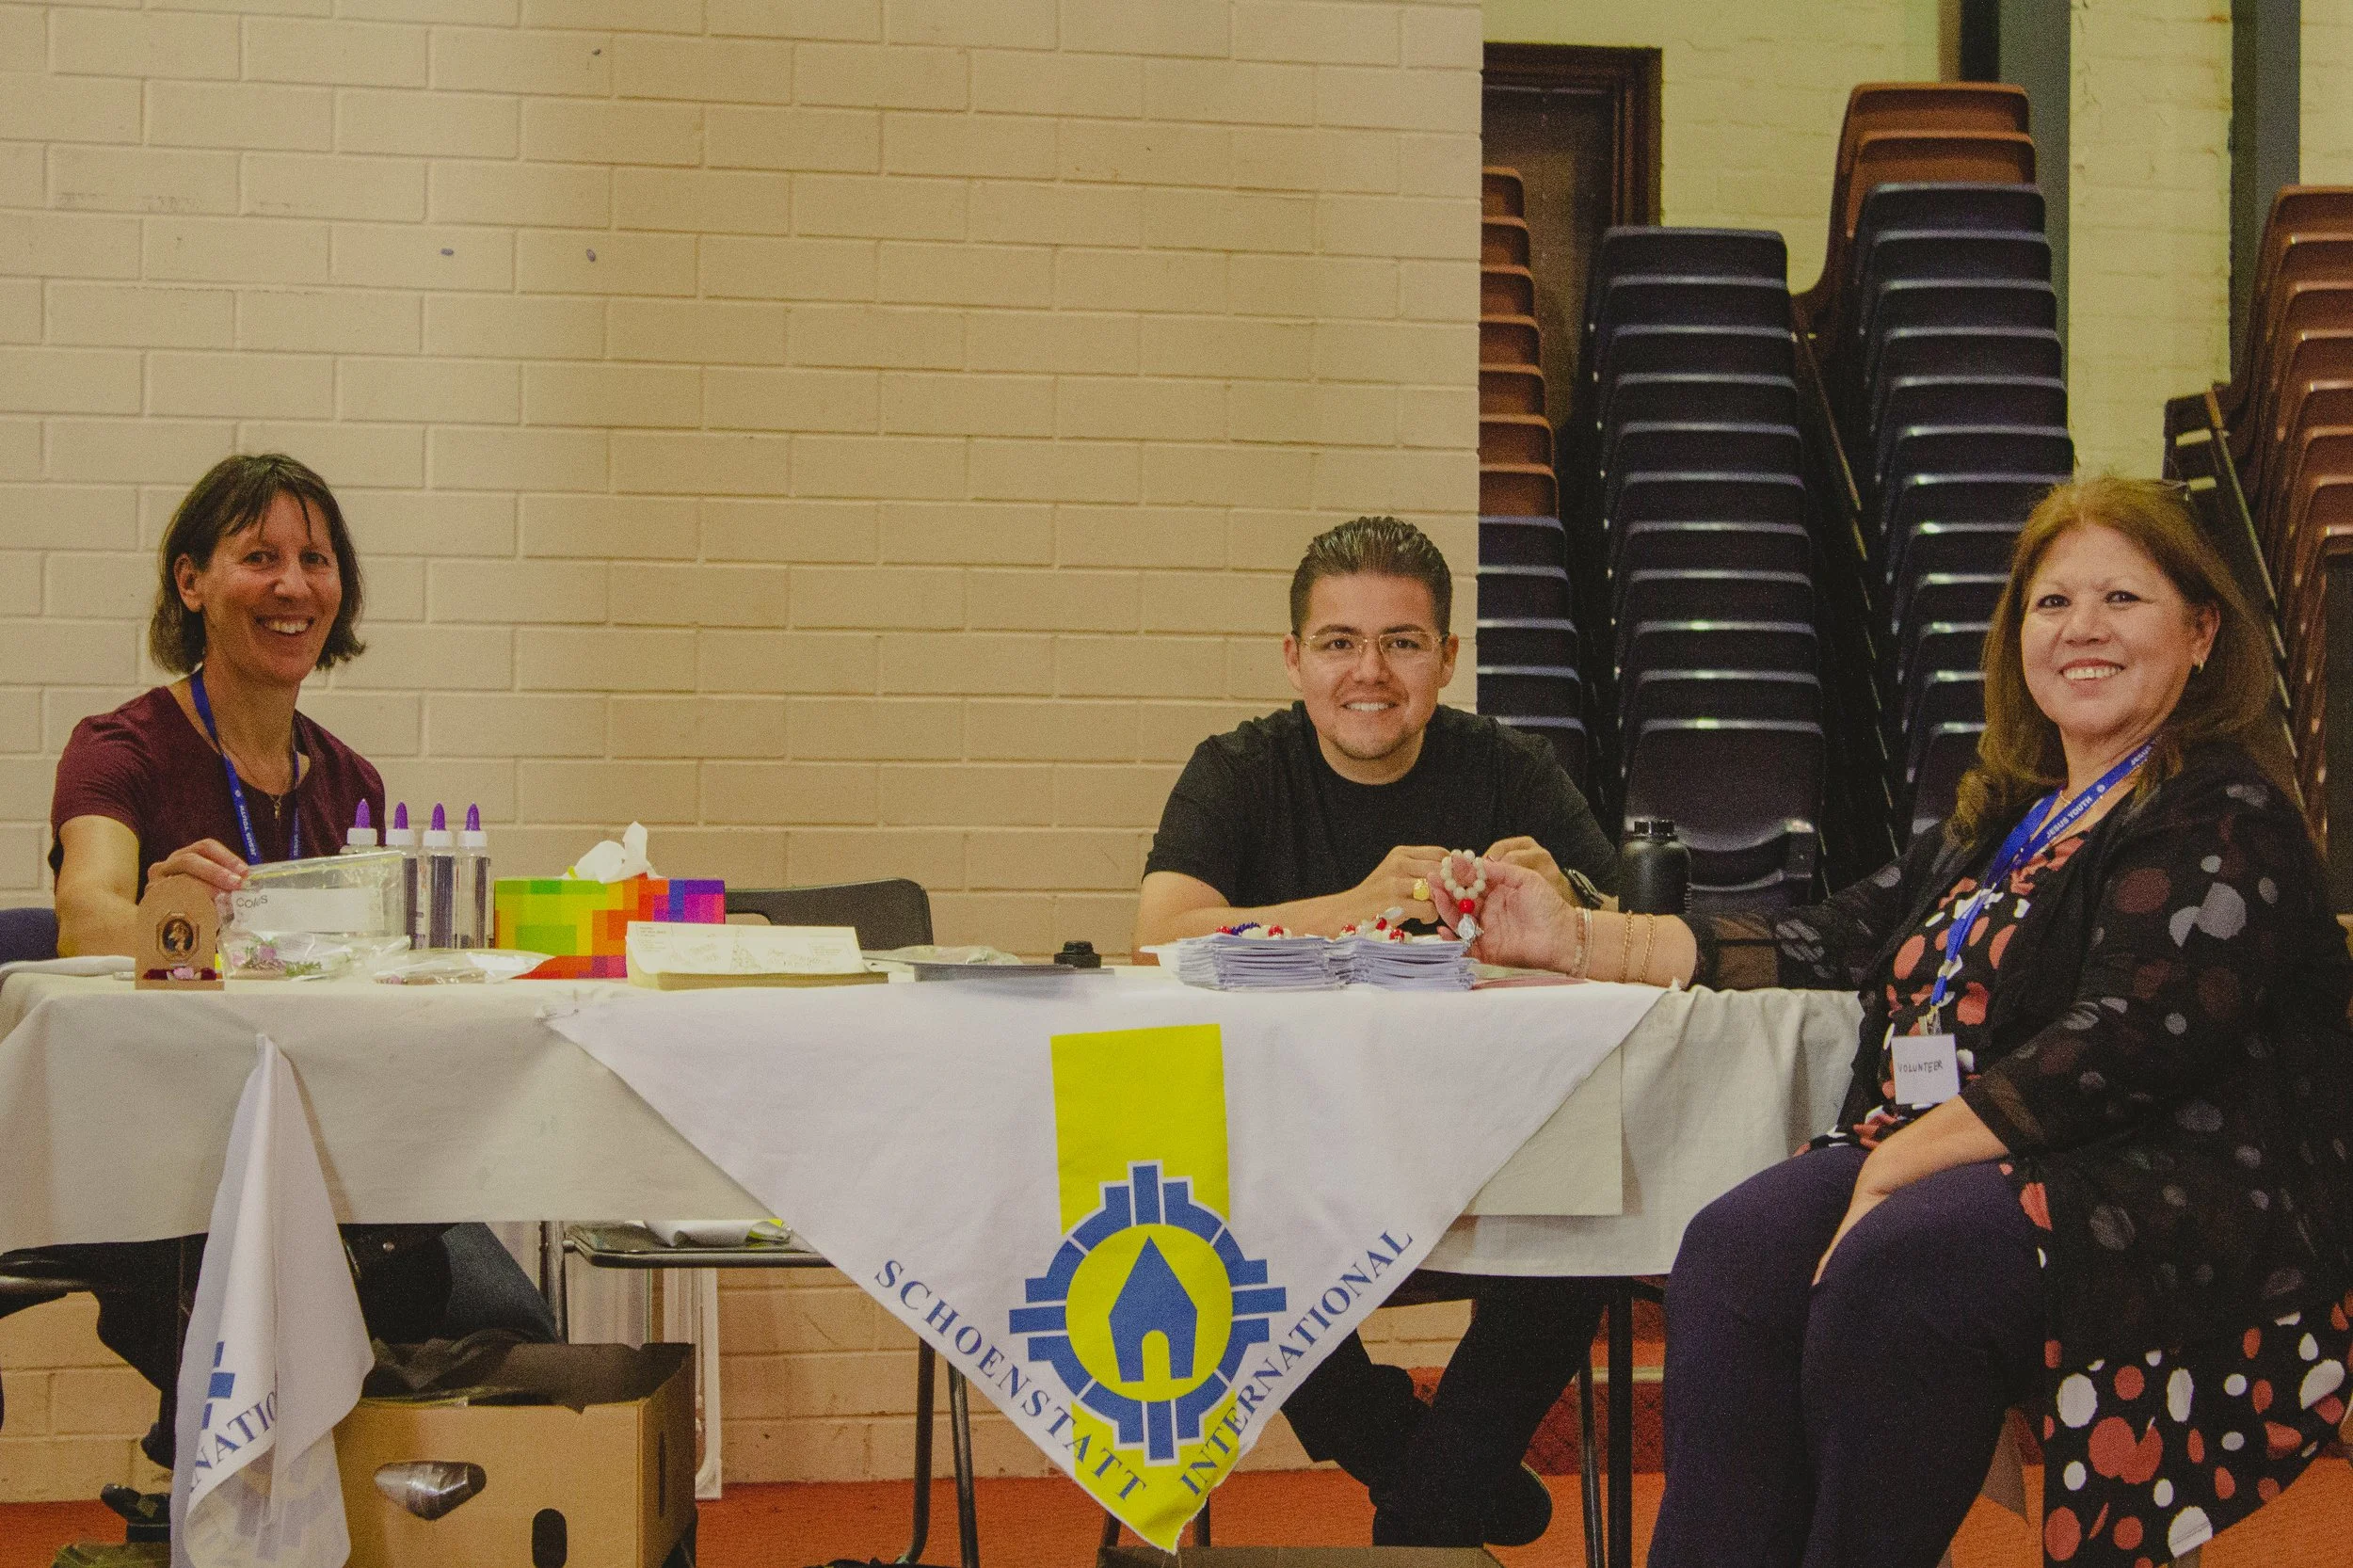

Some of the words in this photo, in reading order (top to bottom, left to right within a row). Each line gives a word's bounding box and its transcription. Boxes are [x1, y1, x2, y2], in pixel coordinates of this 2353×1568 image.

[239, 805, 249, 831] YOUTH
[2046, 816, 2070, 839] JESUS
[2068, 796, 2093, 819] YOUTH
[246, 833, 256, 856] JESUS
[1897, 1060, 1944, 1073] VOLUNTEER
[873, 1258, 1147, 1502] SCHOENSTATT
[1178, 1228, 1414, 1497] INTERNATIONAL
[190, 1391, 276, 1493] NATIO
